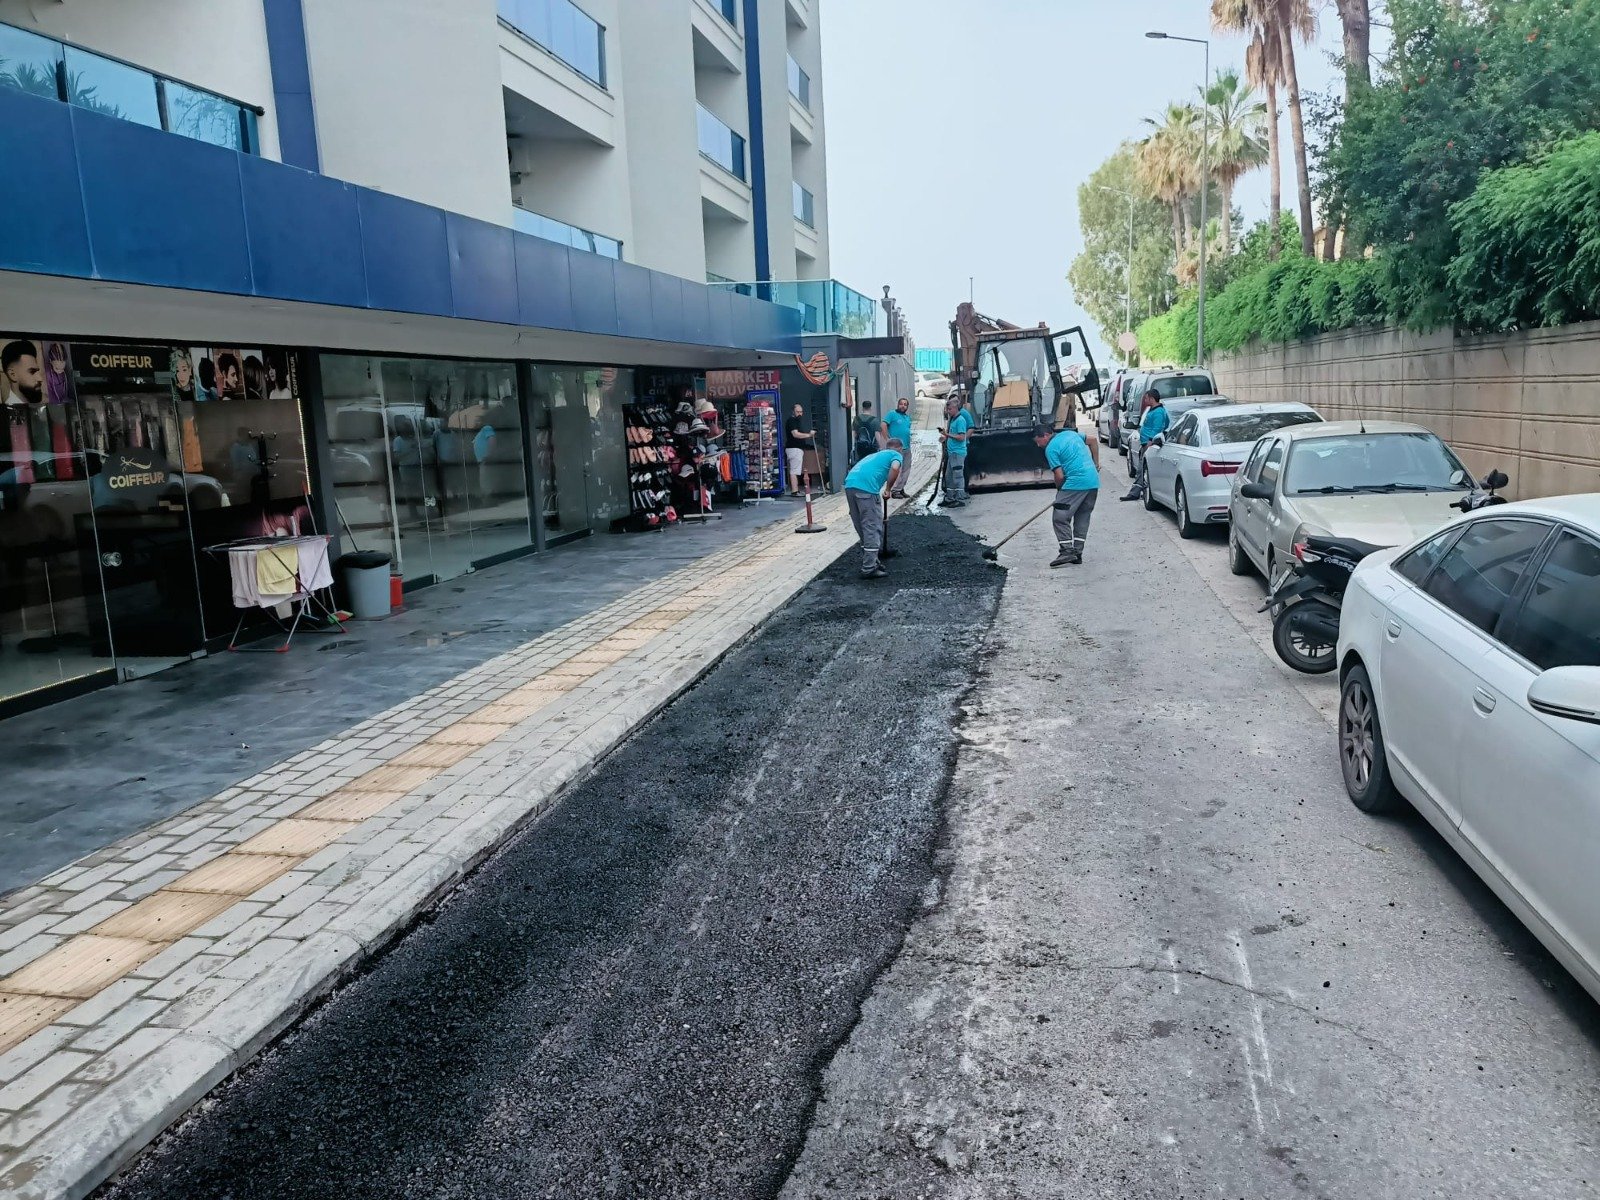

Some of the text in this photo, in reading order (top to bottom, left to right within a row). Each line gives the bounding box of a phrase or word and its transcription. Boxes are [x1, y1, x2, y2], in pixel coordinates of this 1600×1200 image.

[90, 354, 153, 369] COIFFEUR
[289, 356, 298, 396] COIFFEUR
[711, 371, 774, 384] MARKET
[109, 472, 165, 489] COIFFEUR
